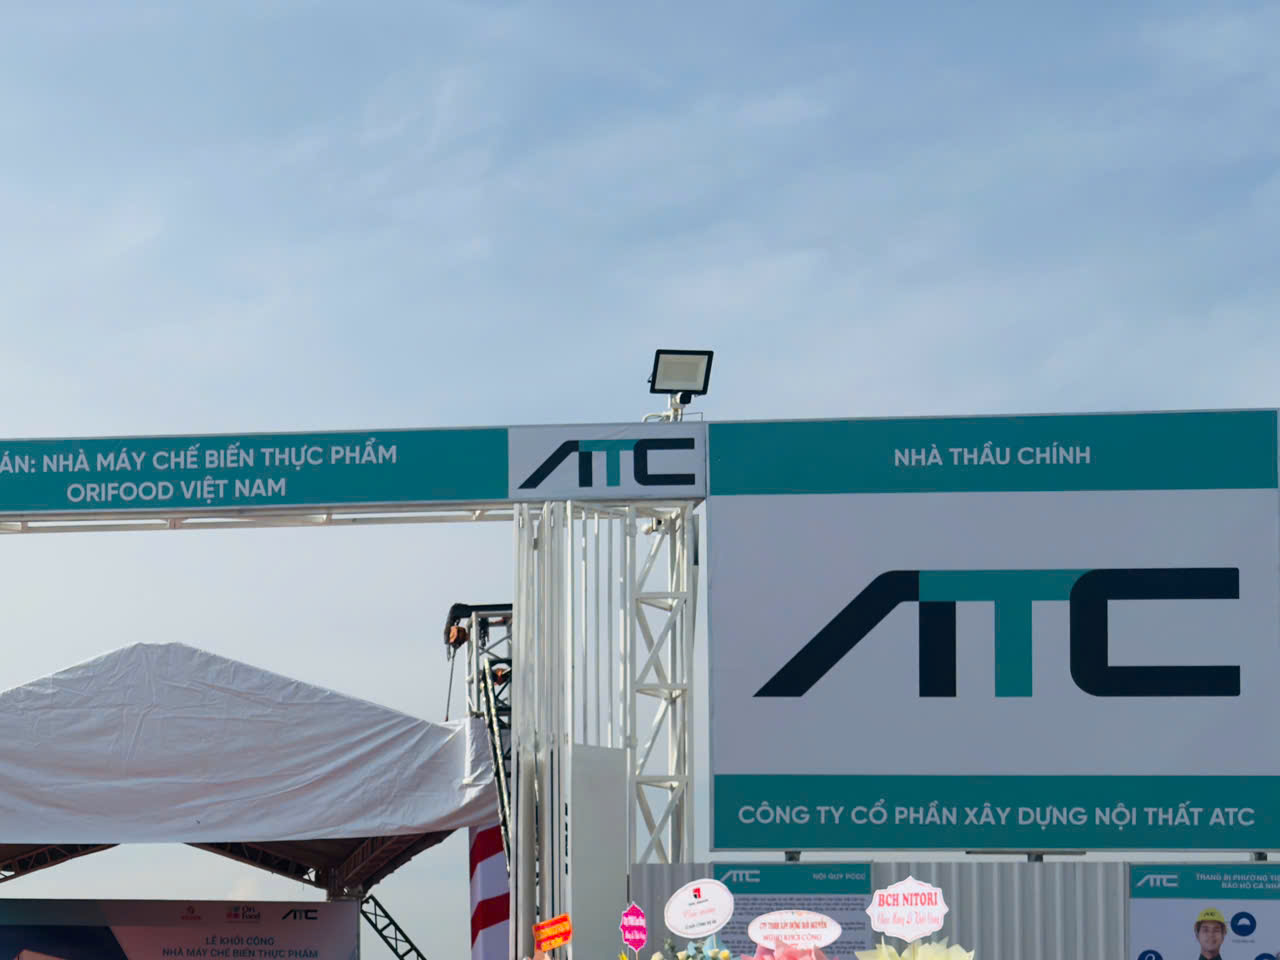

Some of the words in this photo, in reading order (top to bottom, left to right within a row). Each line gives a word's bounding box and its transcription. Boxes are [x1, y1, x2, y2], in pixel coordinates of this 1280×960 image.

[43, 452, 90, 472] NHÀ
[96, 449, 145, 471] MÁY
[153, 444, 200, 470] CHẾ
[205, 443, 254, 468] BIẾN
[261, 446, 322, 470] THỰC
[331, 438, 396, 466] PHẨM
[518, 438, 695, 489] ATC
[895, 444, 943, 466] NHÀ
[949, 441, 1010, 465] THẦU
[1017, 442, 1090, 464] CHÍNH
[67, 481, 173, 502] ORIFOOD
[180, 476, 228, 503] VIỆT
[234, 478, 285, 497] NAM
[753, 567, 1240, 697] ATC
[738, 801, 810, 825] CÔNG
[816, 806, 846, 825] TY
[851, 799, 888, 825] CỔ
[895, 798, 958, 825] PHẦN
[964, 803, 1011, 825] XÂY
[1018, 806, 1087, 830] DỰNG
[1095, 803, 1136, 831] NỘI
[1144, 800, 1203, 826] THẤT
[1209, 807, 1255, 826] ATC
[720, 870, 760, 882] ATC
[1136, 874, 1178, 887] ATC
[878, 893, 899, 907] BCH
[903, 892, 938, 906] NITORI
[282, 909, 318, 920] ATC
[163, 946, 183, 956] NHÀ
